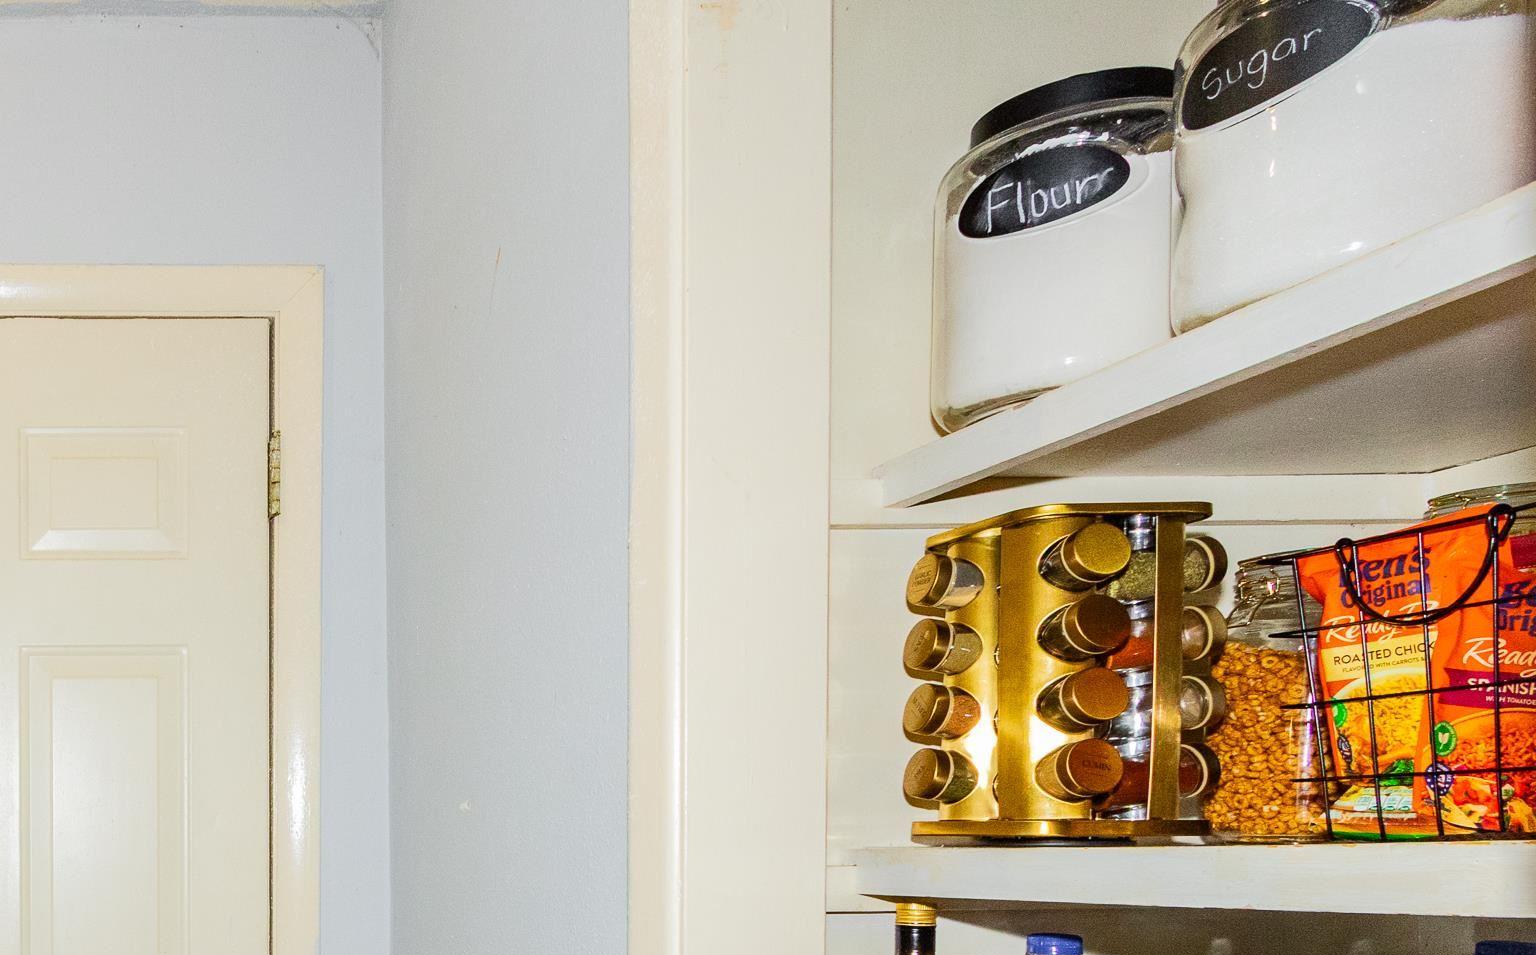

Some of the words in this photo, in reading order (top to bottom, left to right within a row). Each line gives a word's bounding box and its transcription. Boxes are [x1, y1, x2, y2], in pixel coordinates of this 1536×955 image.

[1201, 25, 1322, 100] Sugar
[987, 167, 1114, 234] Flour
[1341, 572, 1432, 609] Oiginal
